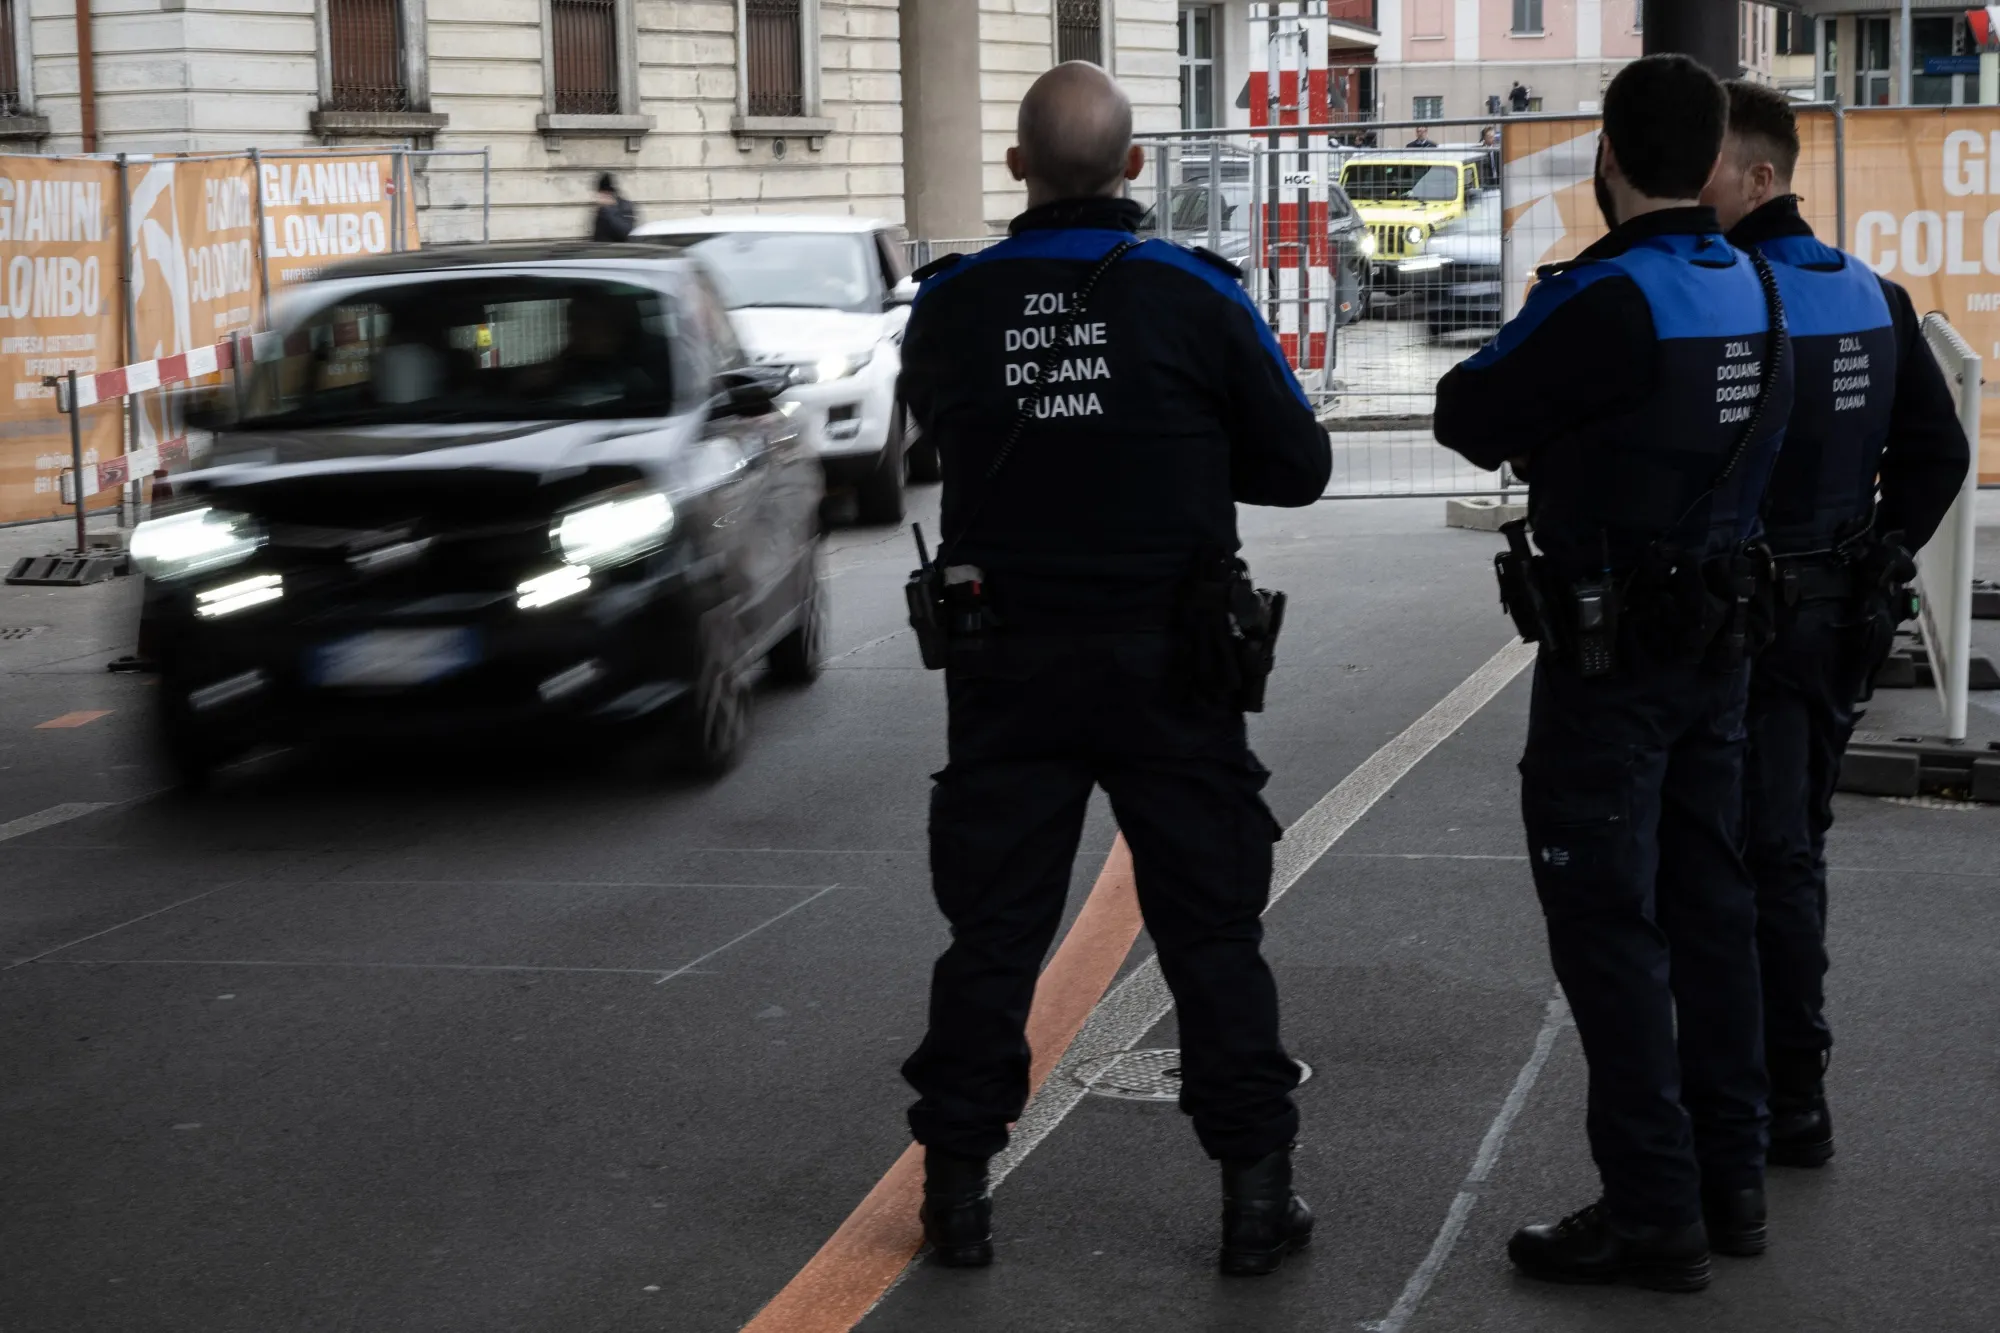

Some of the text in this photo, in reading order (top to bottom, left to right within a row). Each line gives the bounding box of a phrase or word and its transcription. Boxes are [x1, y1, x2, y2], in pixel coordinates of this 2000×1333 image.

[260, 161, 380, 207] GIANINI
[263, 211, 386, 258] LOMBO
[188, 239, 252, 303] COOMBO
[1725, 341, 1752, 358] ZOLL
[1839, 336, 1862, 353] ZOLL
[1717, 361, 1761, 381] DOUANE
[1833, 354, 1870, 373] DOUANE
[1833, 373, 1870, 393] DOGANA
[1835, 394, 1865, 412] DUANA
[1720, 405, 1753, 424] DUAN
